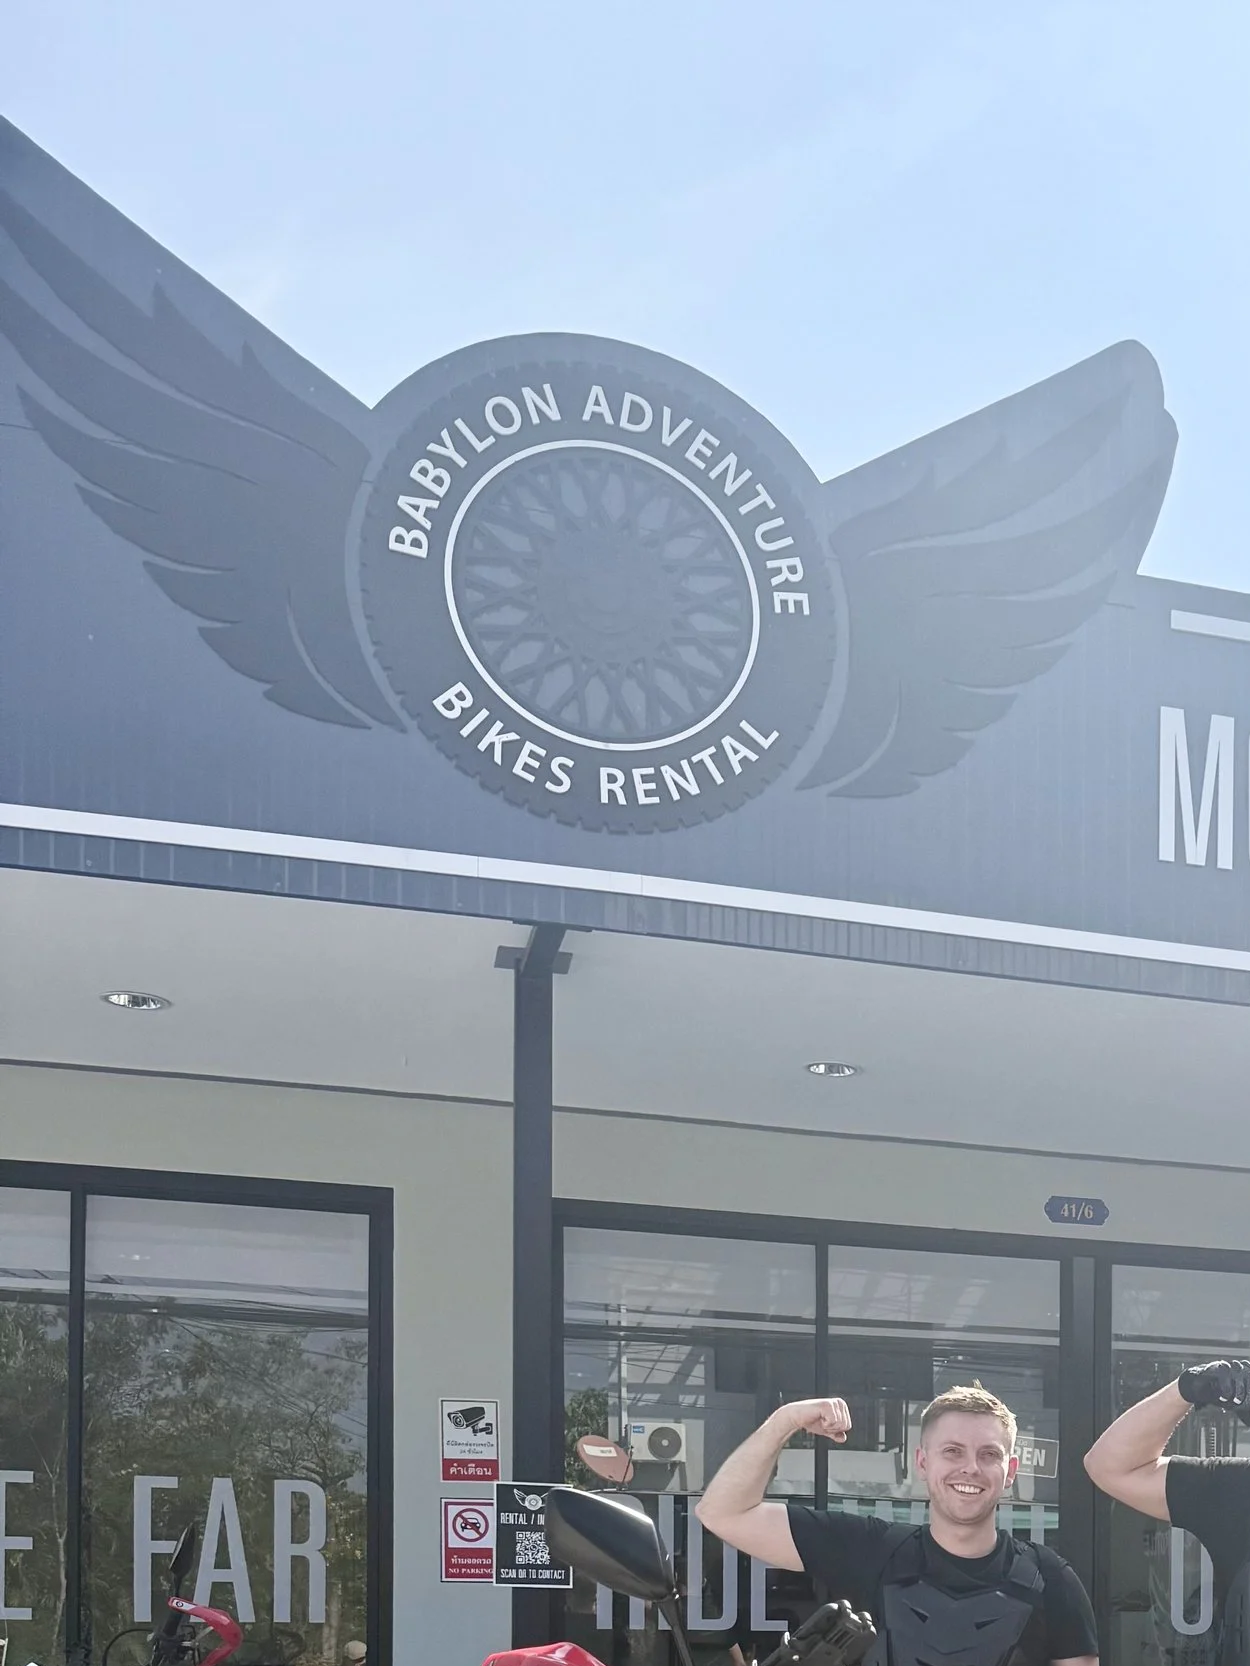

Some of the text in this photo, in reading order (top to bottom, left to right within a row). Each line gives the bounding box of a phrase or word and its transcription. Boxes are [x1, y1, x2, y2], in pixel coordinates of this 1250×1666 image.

[388, 383, 811, 616] BABYLON ADVENTURE
[432, 681, 780, 806] BIKES RENTAL
[1060, 1202, 1094, 1221] 41/6
[449, 1462, 493, 1477] คำเตือน
[500, 1512, 528, 1525] RENTAL
[133, 1475, 328, 1625] FAR
[450, 1554, 492, 1565] ห้ามจอดรถ
[448, 1567, 460, 1575] NO
[500, 1568, 517, 1579] SCAN
[528, 1569, 537, 1579] TO
[538, 1569, 566, 1580] CONTACT
